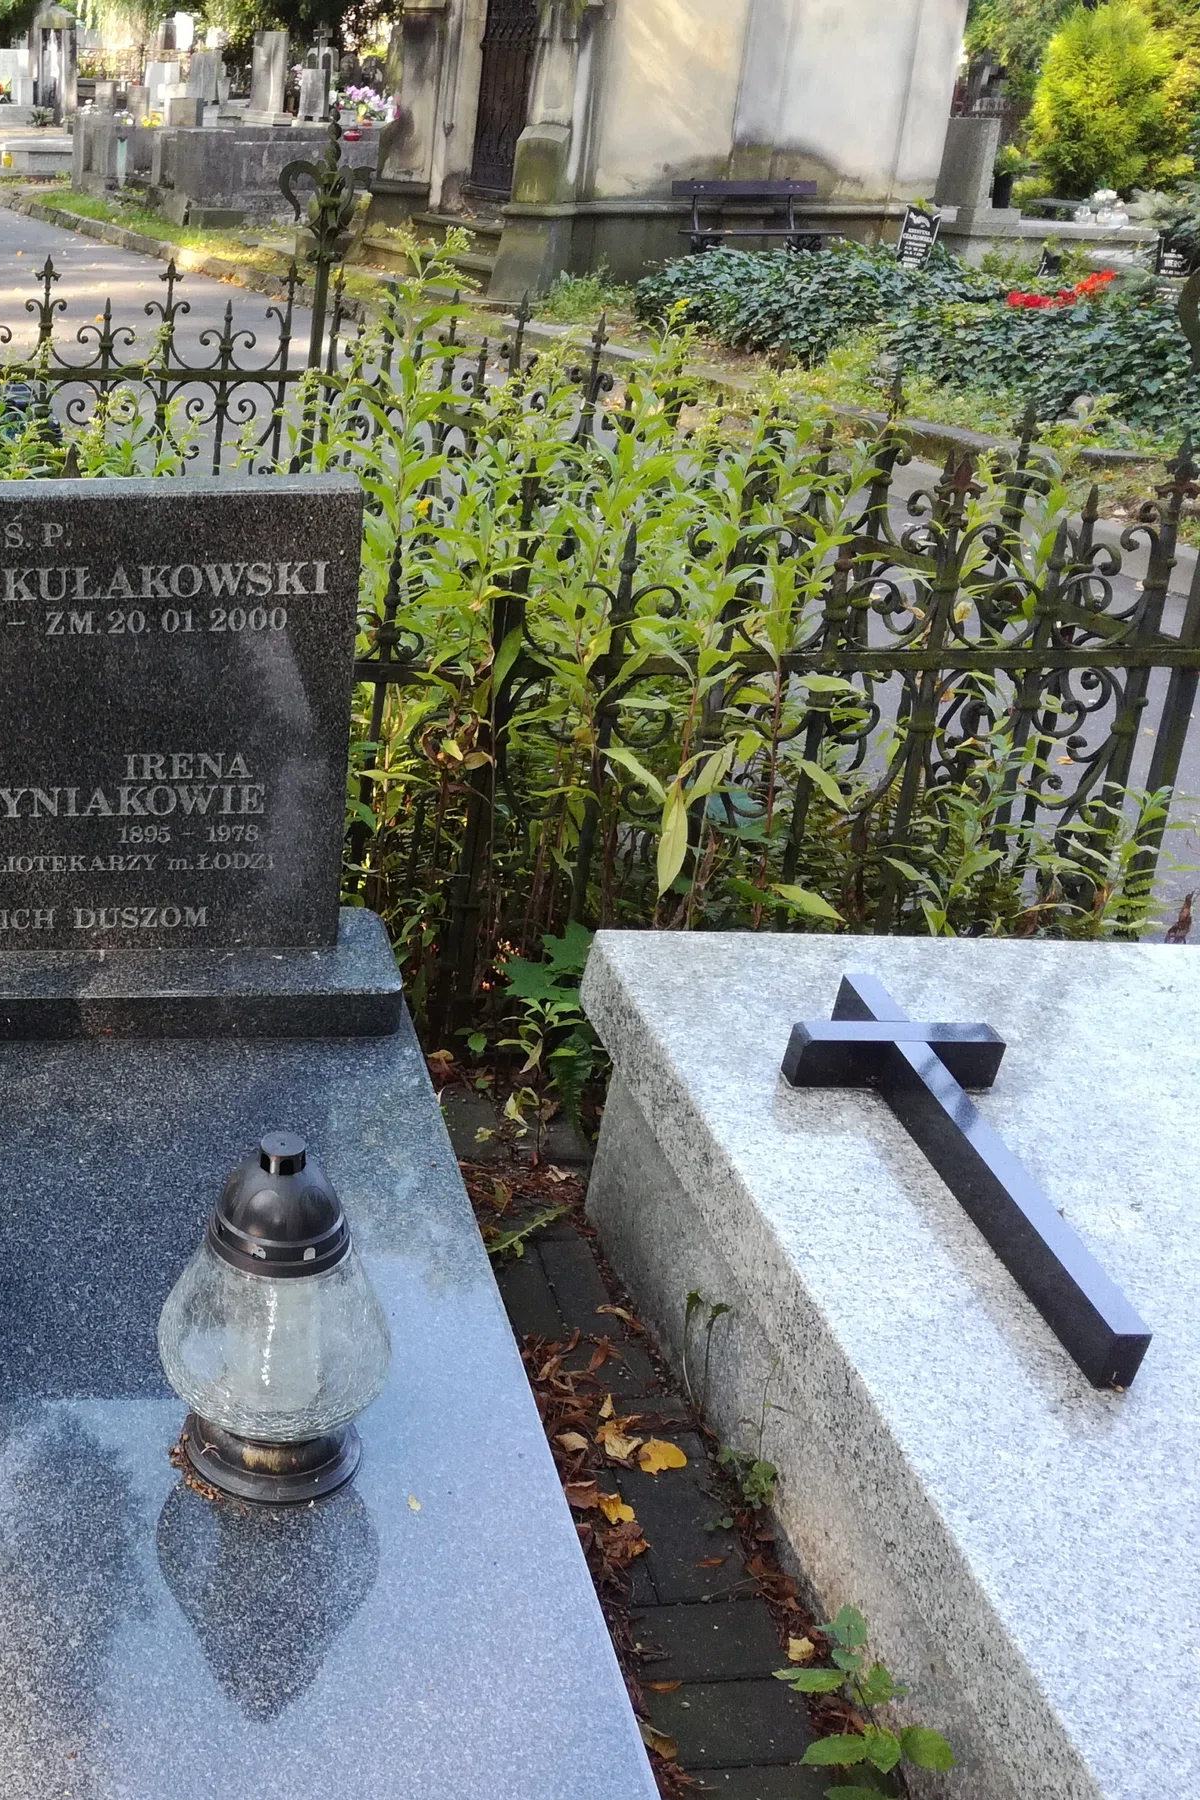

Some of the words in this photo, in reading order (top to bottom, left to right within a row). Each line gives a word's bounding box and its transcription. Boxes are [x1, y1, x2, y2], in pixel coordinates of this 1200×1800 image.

[4, 514, 31, 548] Ś.
[41, 522, 73, 547] P.
[2, 561, 330, 601] KUŁAKOWSKI
[209, 606, 288, 632] 2000
[123, 752, 253, 780] IRENA
[117, 825, 171, 844] 1895
[205, 825, 259, 843] 1978
[74, 906, 209, 930] DUSZOM
